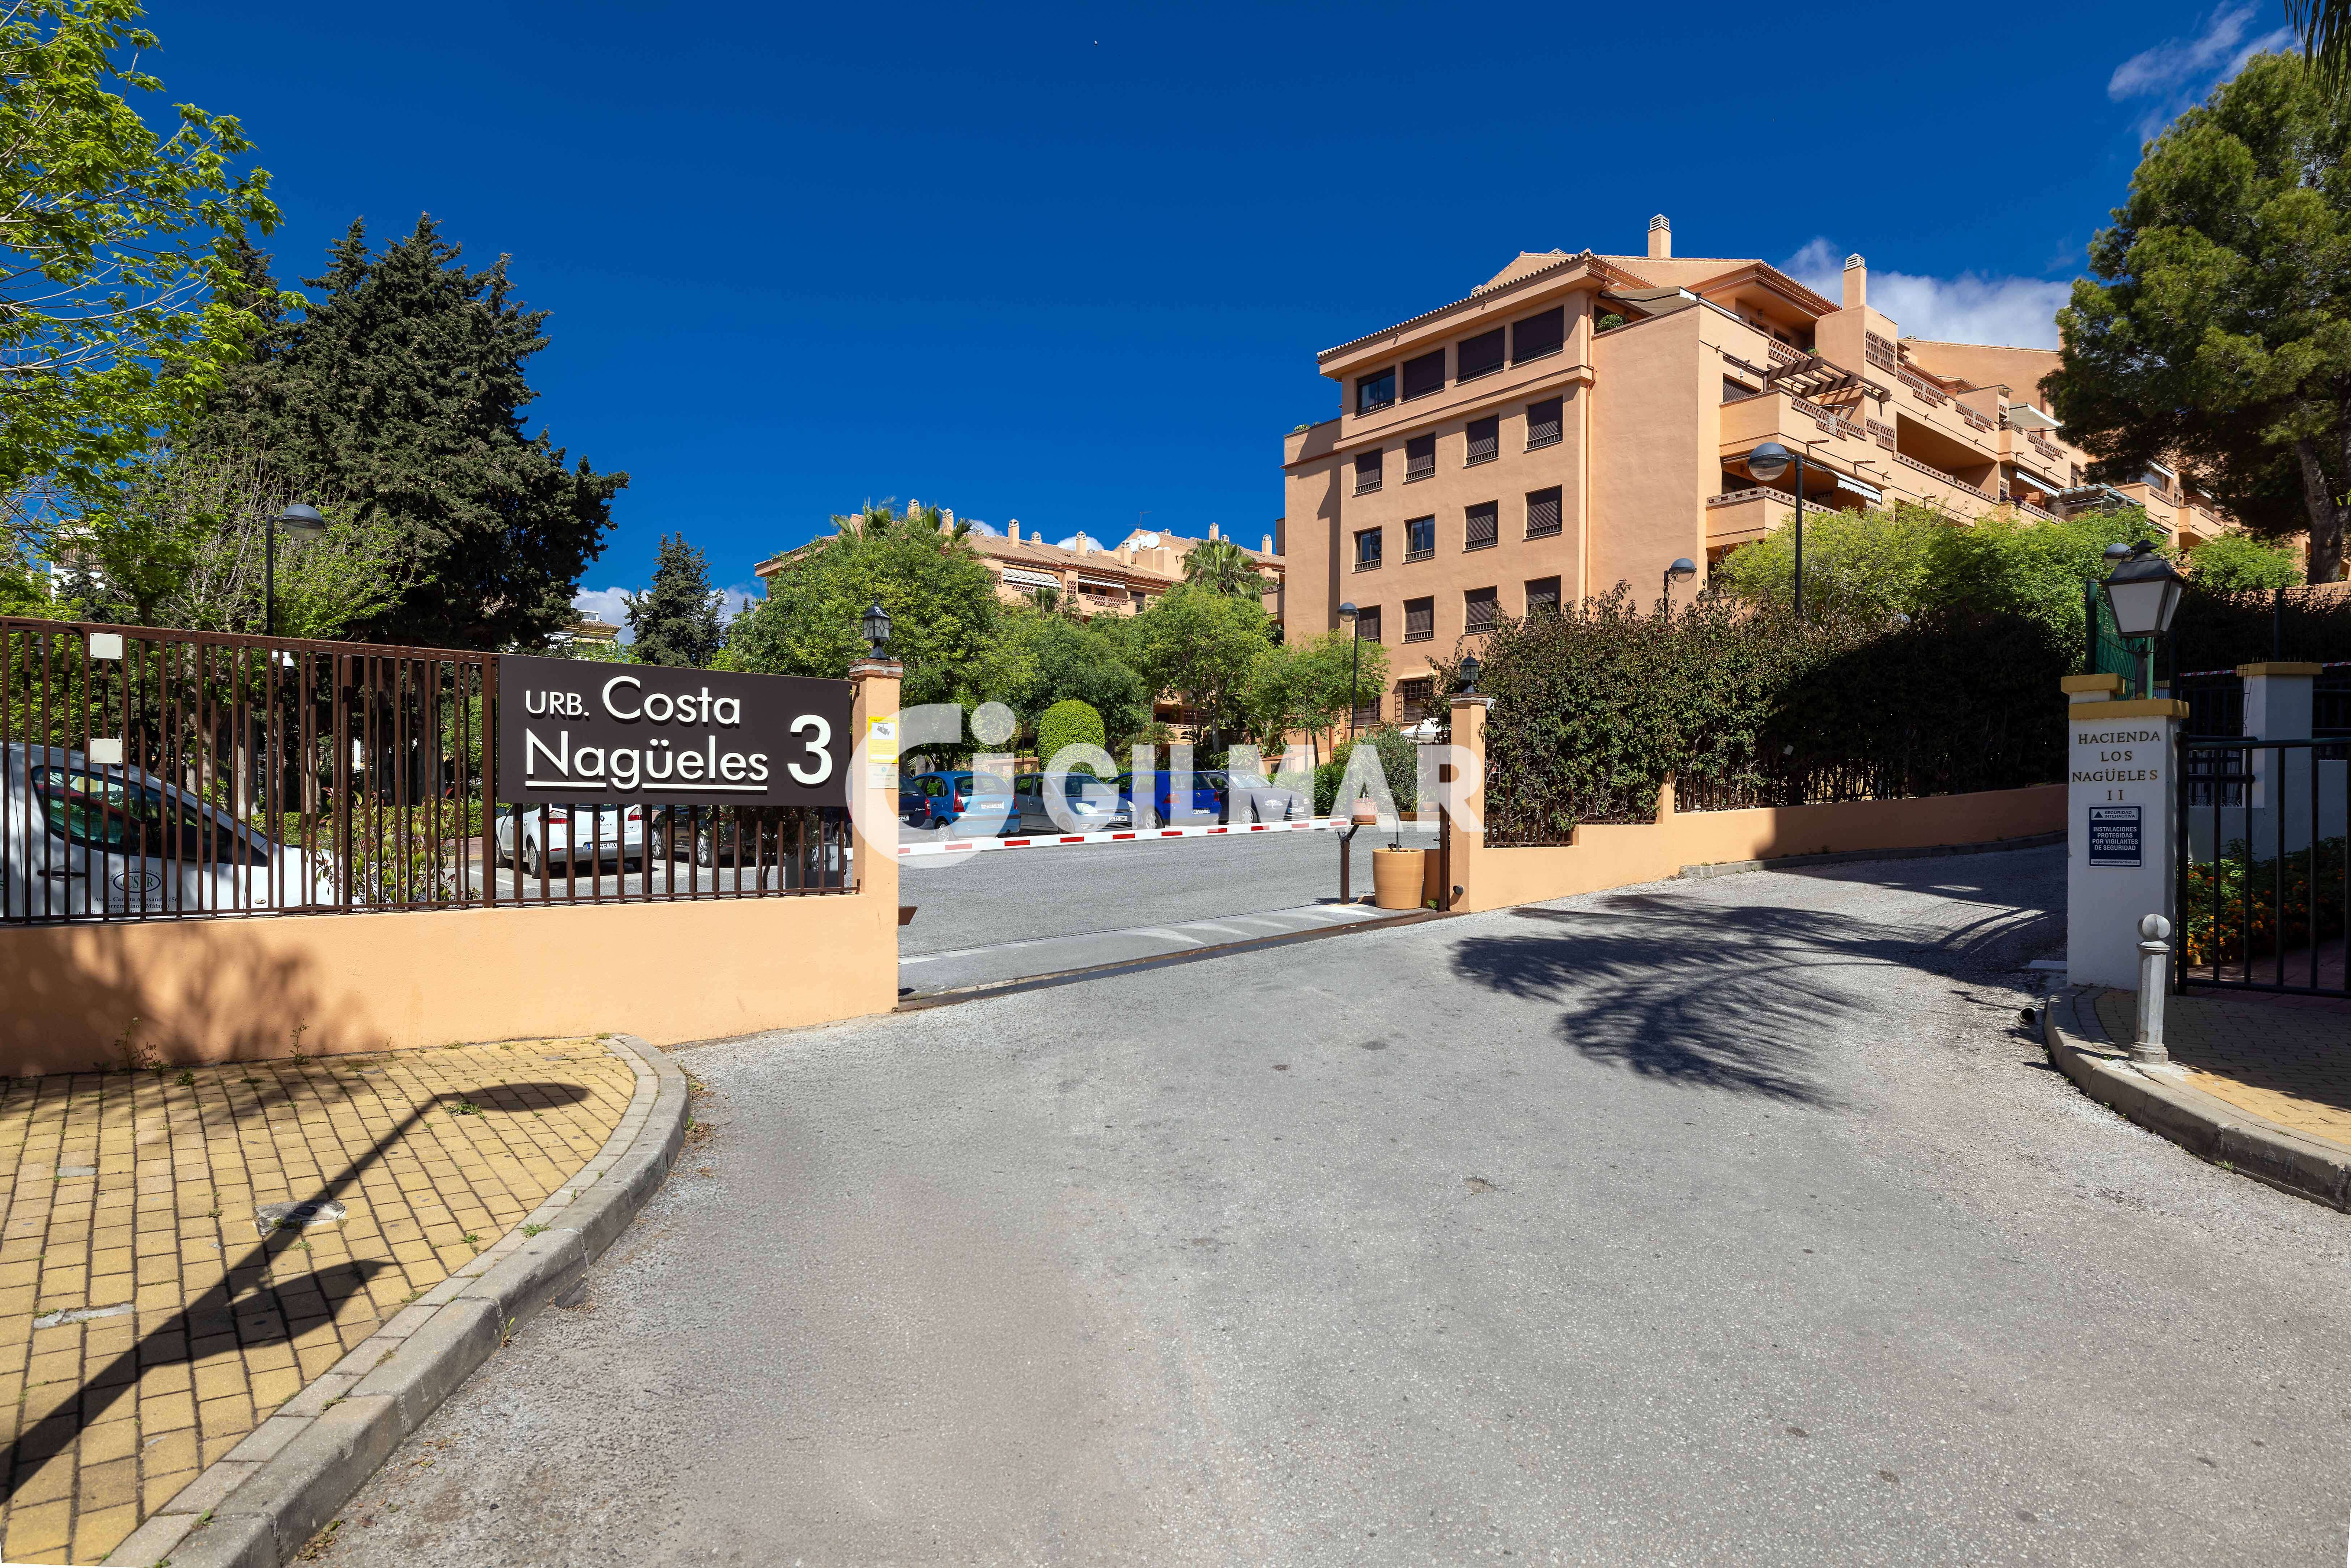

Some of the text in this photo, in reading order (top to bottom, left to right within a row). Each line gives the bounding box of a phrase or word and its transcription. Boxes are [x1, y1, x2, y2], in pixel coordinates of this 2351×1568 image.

[525, 676, 740, 724] URB. Costa
[787, 714, 833, 785] 3
[2078, 731, 2160, 744] HACIENDA
[525, 728, 769, 790] Nagüeles
[2100, 750, 2133, 762] LOS
[2072, 768, 2158, 782] NAGÜELES
